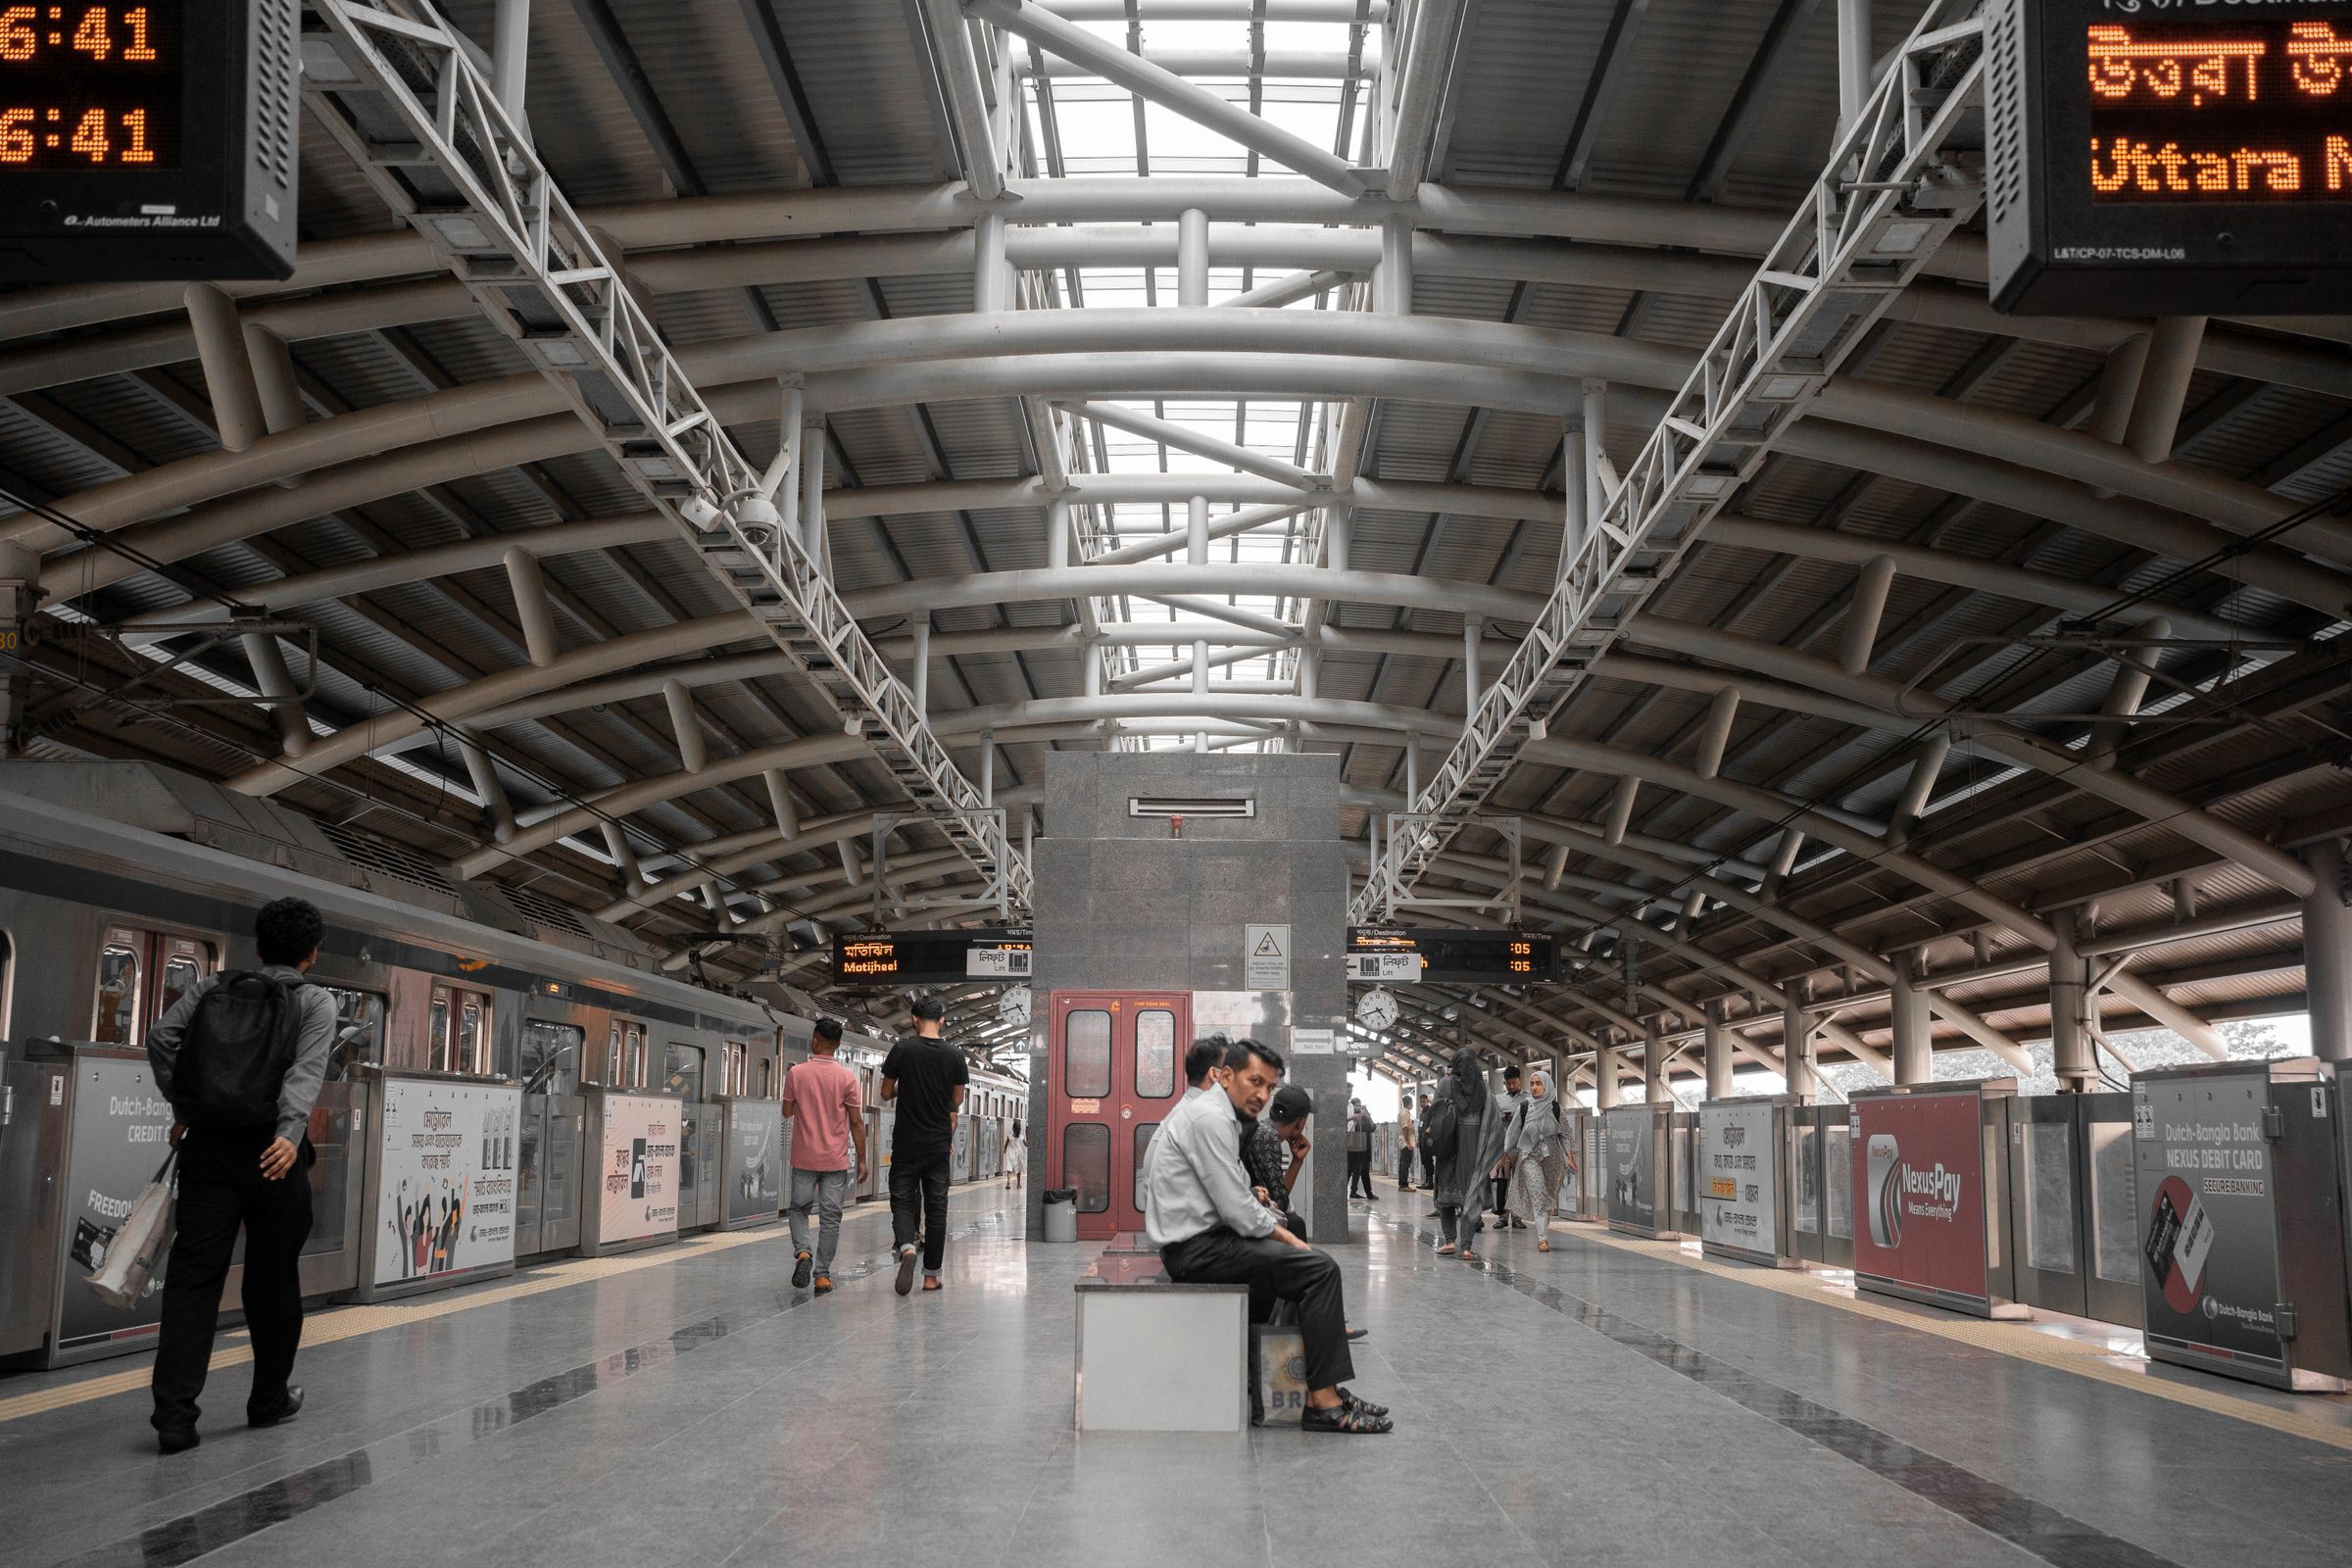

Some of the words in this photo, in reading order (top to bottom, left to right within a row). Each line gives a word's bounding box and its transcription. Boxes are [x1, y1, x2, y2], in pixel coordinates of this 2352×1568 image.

[2091, 138, 2300, 191] Uttara
[85, 216, 150, 226] Autometers
[152, 216, 199, 226] Alliance
[200, 216, 220, 226] Ltd
[844, 959, 898, 974] Motijheel
[128, 1125, 163, 1143] CREDIT
[2165, 1123, 2230, 1146] Dutch-Bangla
[2232, 1123, 2260, 1143] Bank
[2167, 1149, 2199, 1169] NEXUS
[2201, 1149, 2230, 1169] DEBIT
[2232, 1150, 2262, 1170] CARD
[1902, 1162, 1961, 1213] NexusPay
[2204, 1178, 2230, 1194] SECURE
[2230, 1180, 2264, 1196] BANKING
[1908, 1200, 1925, 1216] Means
[1925, 1201, 1953, 1222] Everything
[2218, 1303, 2257, 1322] Dutch-Bangla
[2258, 1309, 2275, 1323] Bank
